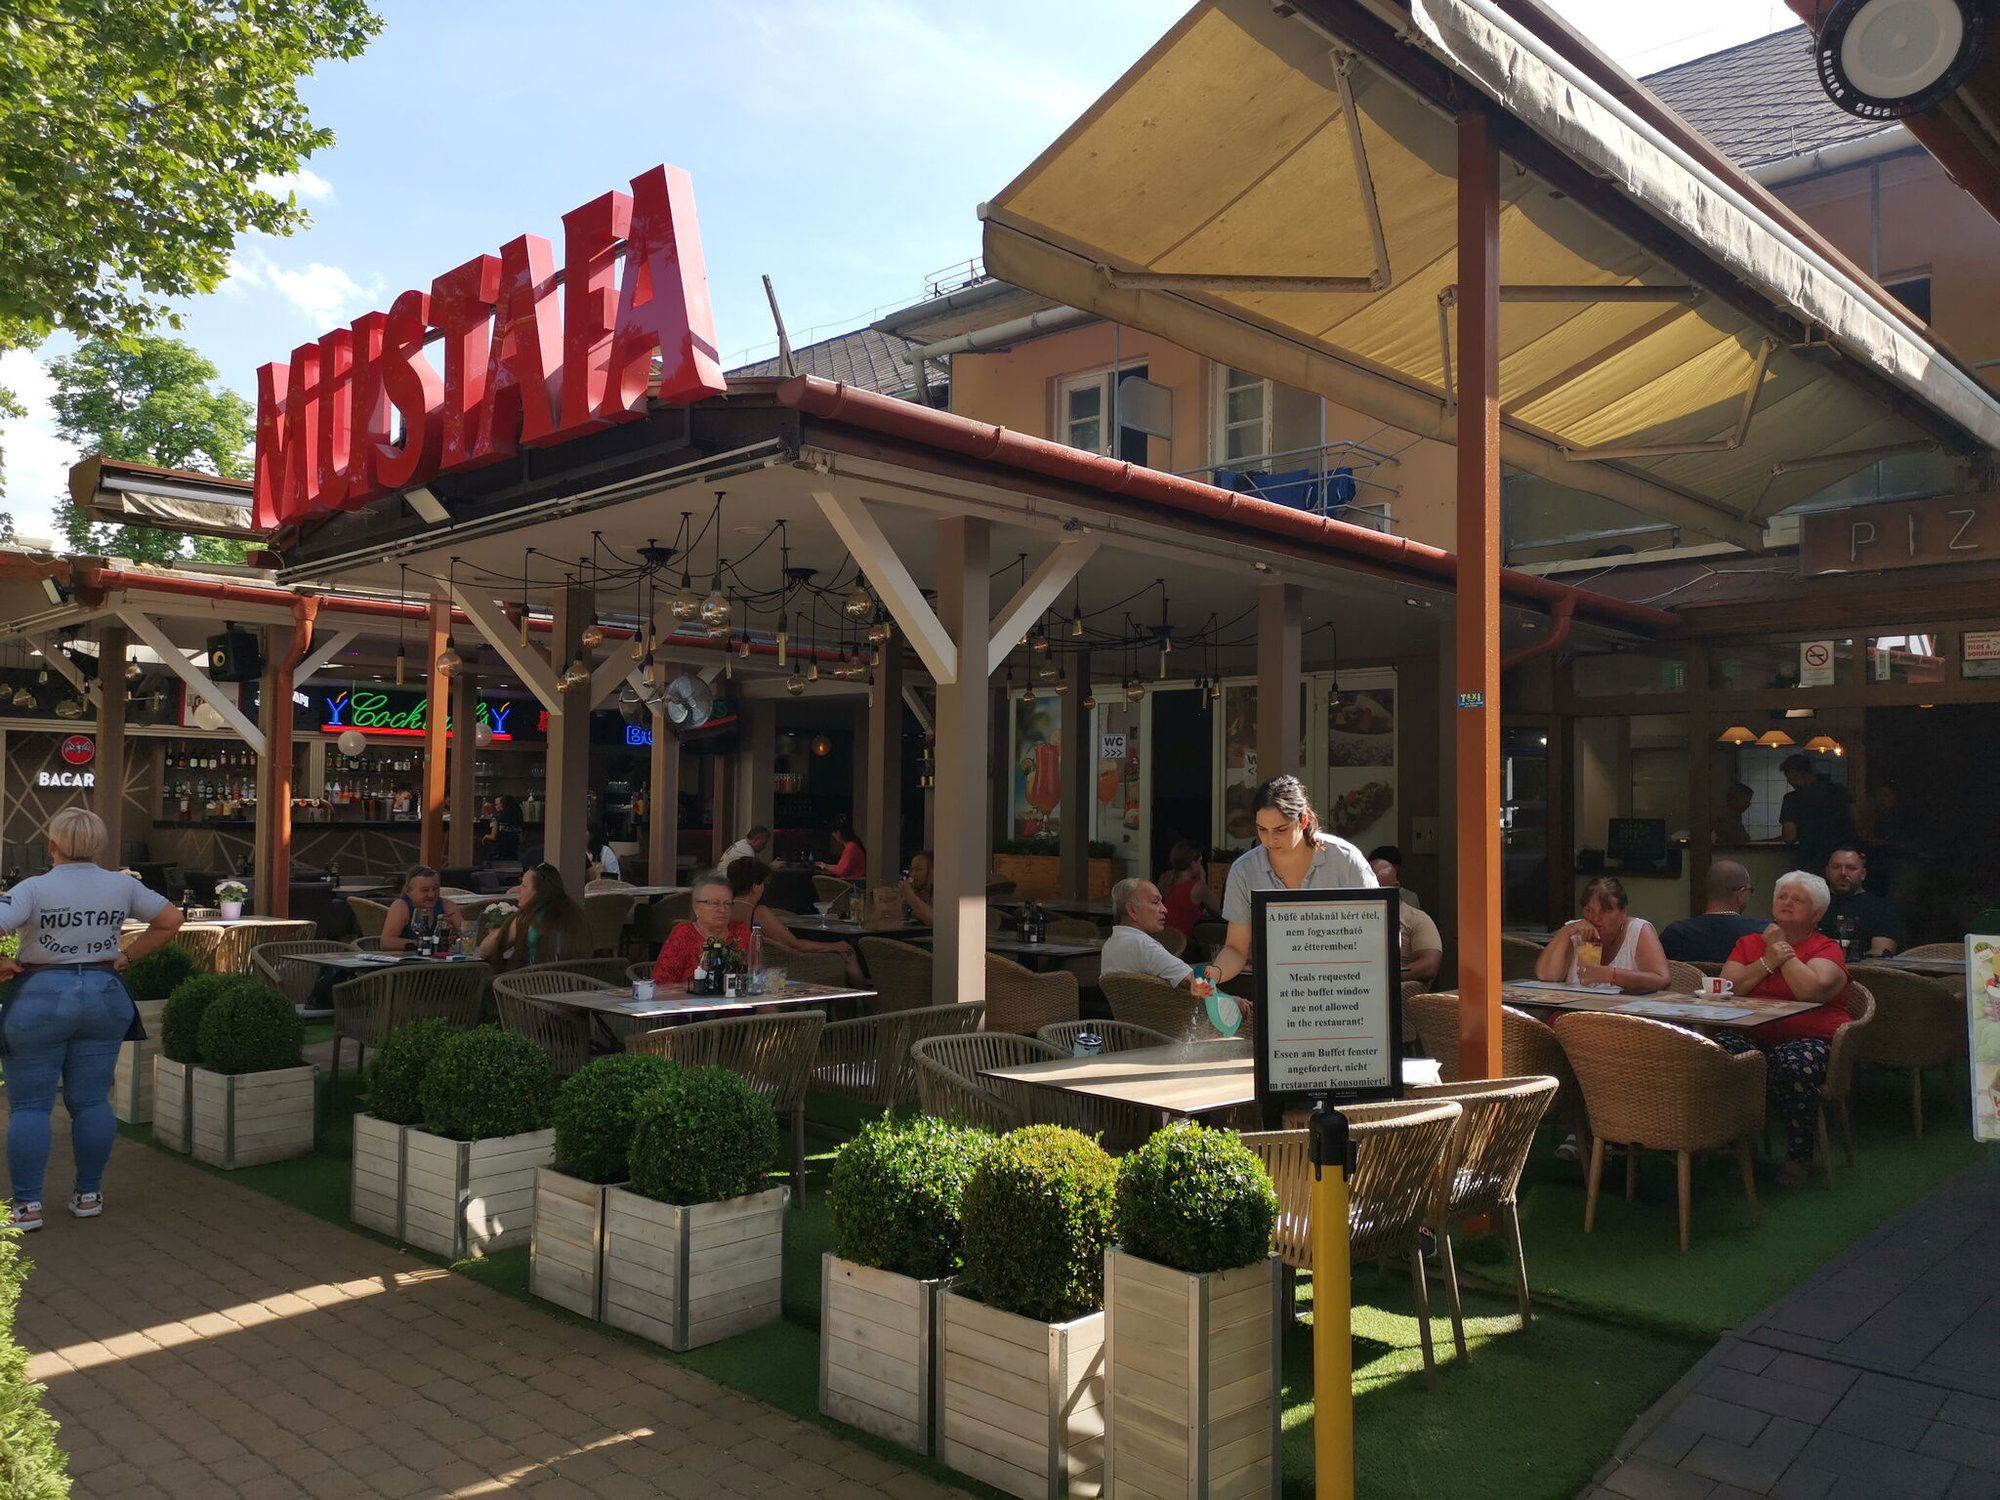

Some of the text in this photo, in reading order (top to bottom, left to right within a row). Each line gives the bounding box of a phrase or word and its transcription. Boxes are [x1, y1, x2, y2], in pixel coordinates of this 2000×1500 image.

[252, 163, 727, 530] MUSTAFA
[1460, 693, 1481, 702] TAXI
[1104, 737, 1123, 746] WC
[39, 772, 95, 787] BACAR
[41, 911, 125, 929] MUSTAFA
[1269, 914, 1276, 922] A
[1300, 912, 1338, 921] ablaknál
[1341, 911, 1359, 920] kért
[1307, 926, 1363, 938] fogyasztható
[40, 934, 78, 954] Since
[1304, 942, 1357, 952] étteremben!
[1289, 972, 1360, 983] Meals requested
[1280, 987, 1370, 997] at the buffet window
[1308, 1004, 1323, 1012] not
[1325, 1002, 1359, 1011] allowed
[1287, 1017, 1364, 1028] in the restaurant!
[1274, 1050, 1299, 1059] Essen
[1318, 1048, 1345, 1057] Buffet
[1347, 1047, 1378, 1057] fenster
[1287, 1063, 1368, 1075] angefordert, nicht
[1281, 1080, 1327, 1090] restaurant
[1330, 1077, 1385, 1088] Konsumiert!
